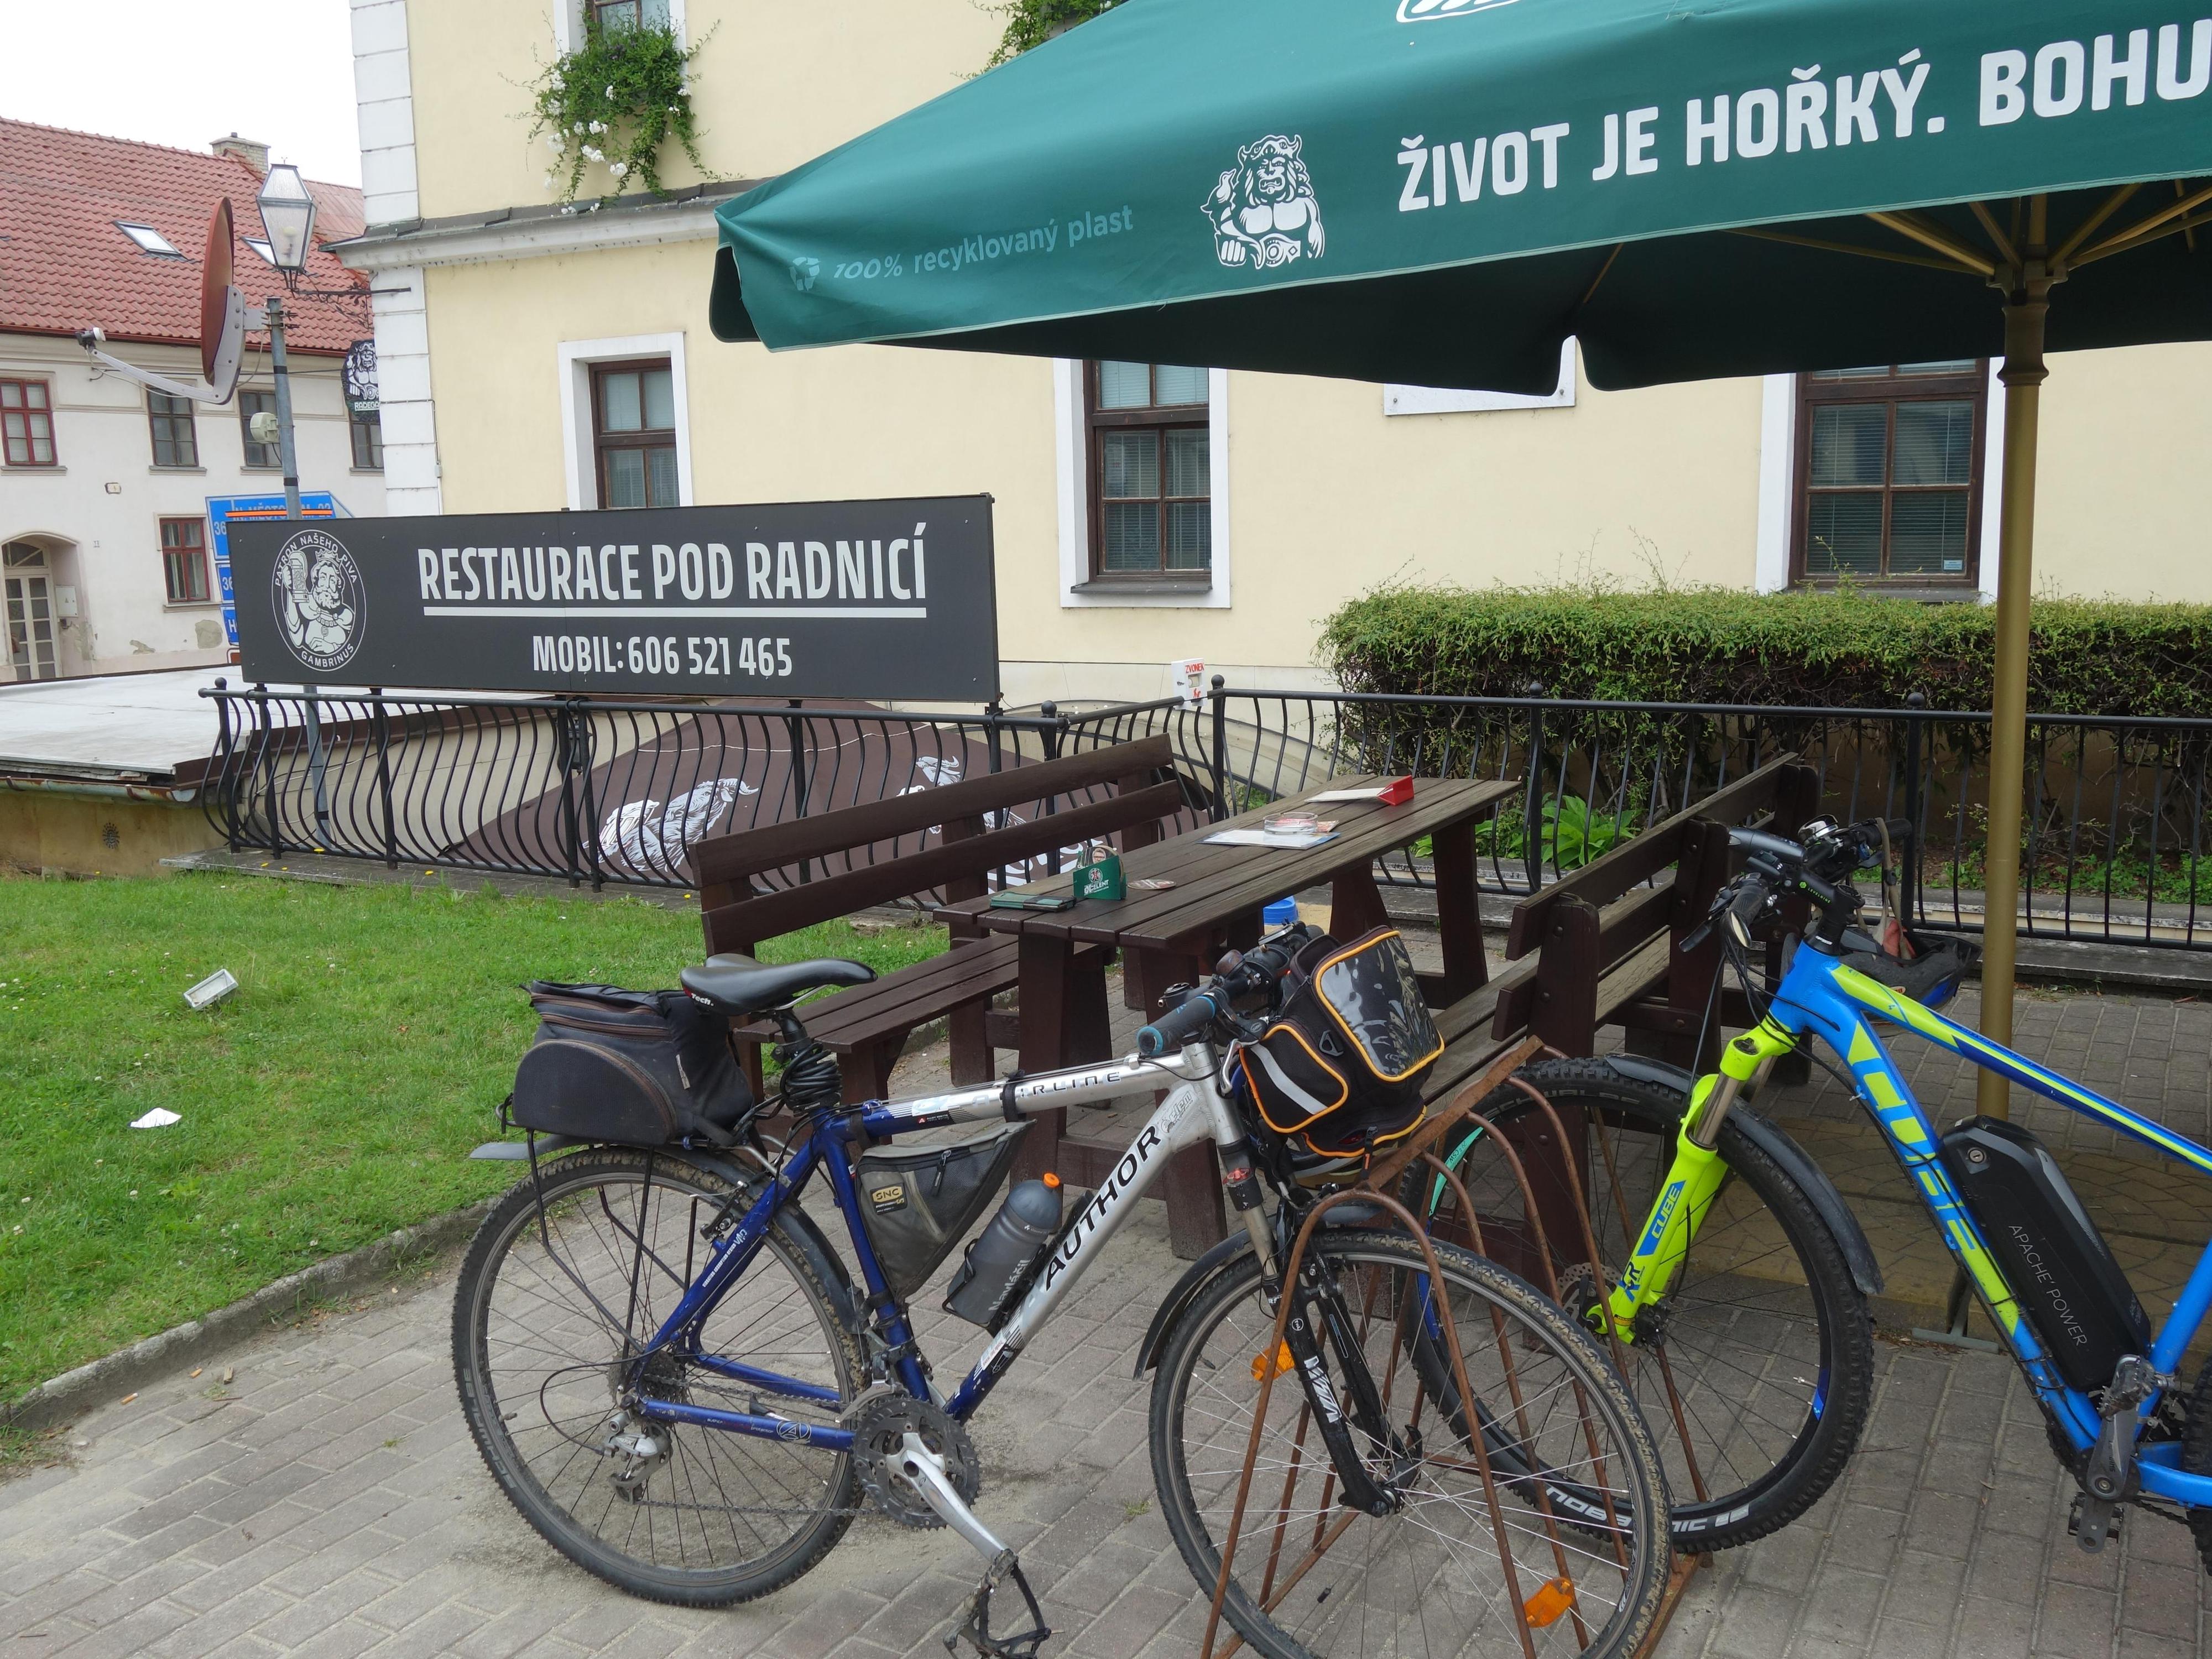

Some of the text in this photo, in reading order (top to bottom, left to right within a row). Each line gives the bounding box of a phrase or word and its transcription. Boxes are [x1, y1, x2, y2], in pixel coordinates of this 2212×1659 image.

[1397, 123, 1569, 211] ŽIVOT
[1593, 107, 1658, 180] JE
[1687, 49, 1944, 165] HOŘKÝ.
[834, 205, 1133, 278] 100% recyklovaný plast
[275, 532, 358, 586] PATRON NAŠEHO PIVA
[418, 523, 926, 601] RESTAURACE POD RADNICÍ
[301, 643, 354, 668] GAMBRINUS
[688, 637, 730, 674] 521
[739, 638, 792, 676] 465
[1185, 662, 1204, 674] ZVONEK
[875, 1188, 900, 1201] SNC
[1046, 1126, 1161, 1292] AUTHOR
[1651, 1185, 1680, 1239] CUBE
[2046, 1288, 2088, 1347] POWER
